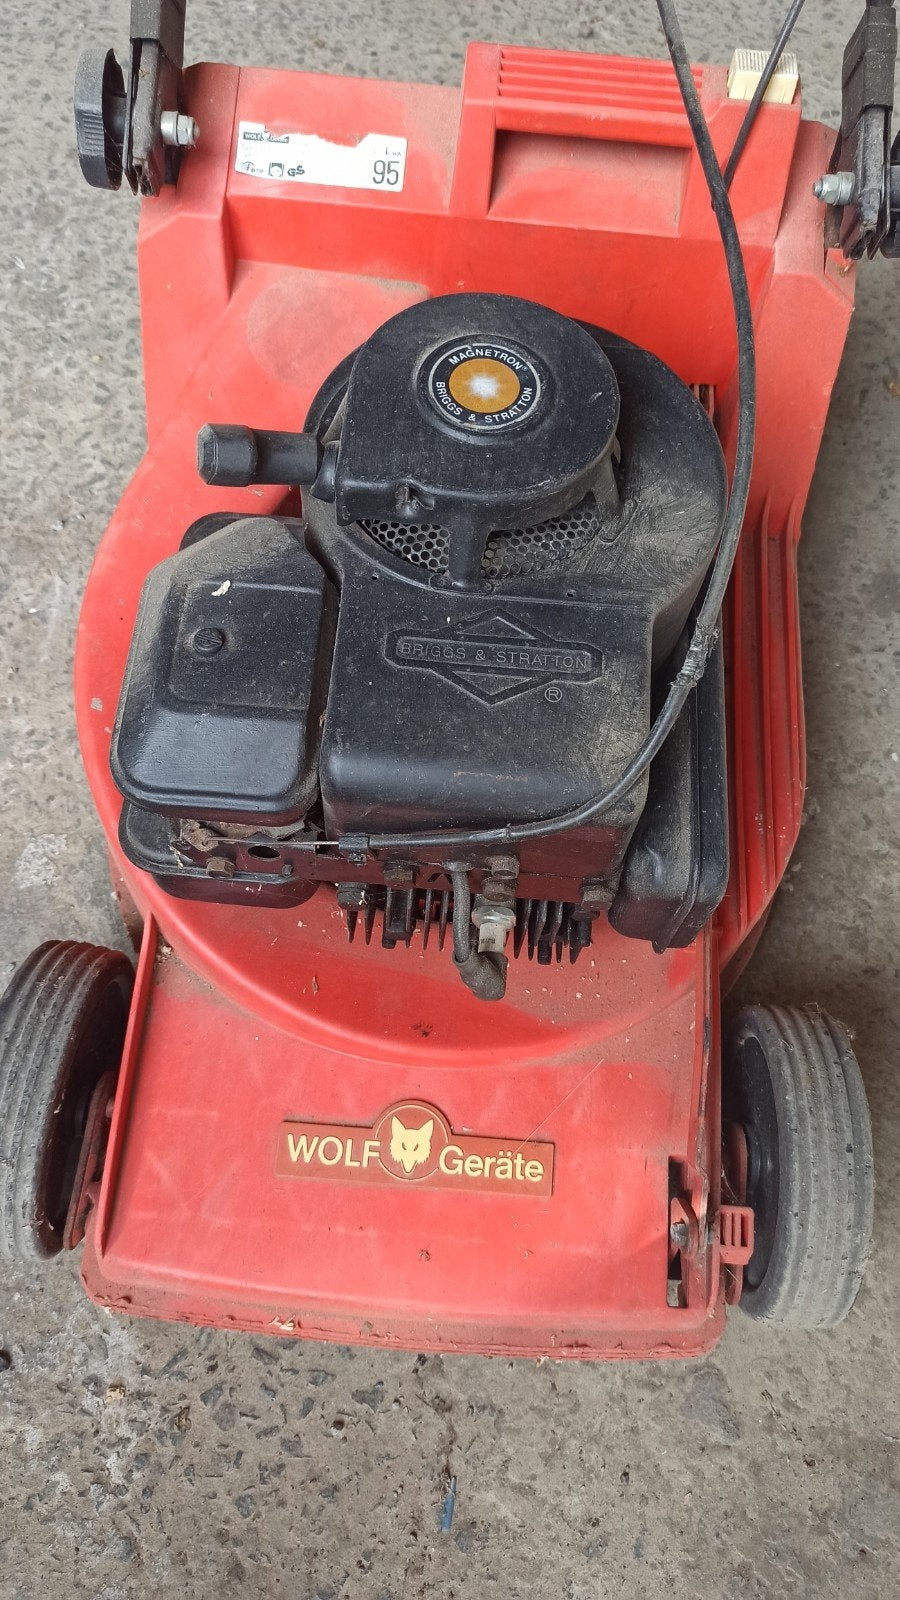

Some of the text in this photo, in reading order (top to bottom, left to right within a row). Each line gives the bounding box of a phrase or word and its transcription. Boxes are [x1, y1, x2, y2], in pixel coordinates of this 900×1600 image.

[287, 165, 306, 178] GS
[372, 159, 400, 186] 95
[436, 381, 533, 423] BRIGGS & STRATTON
[400, 642, 588, 669] BRIGGS & STRATTON
[287, 1133, 545, 1183] WOLF Geräte
